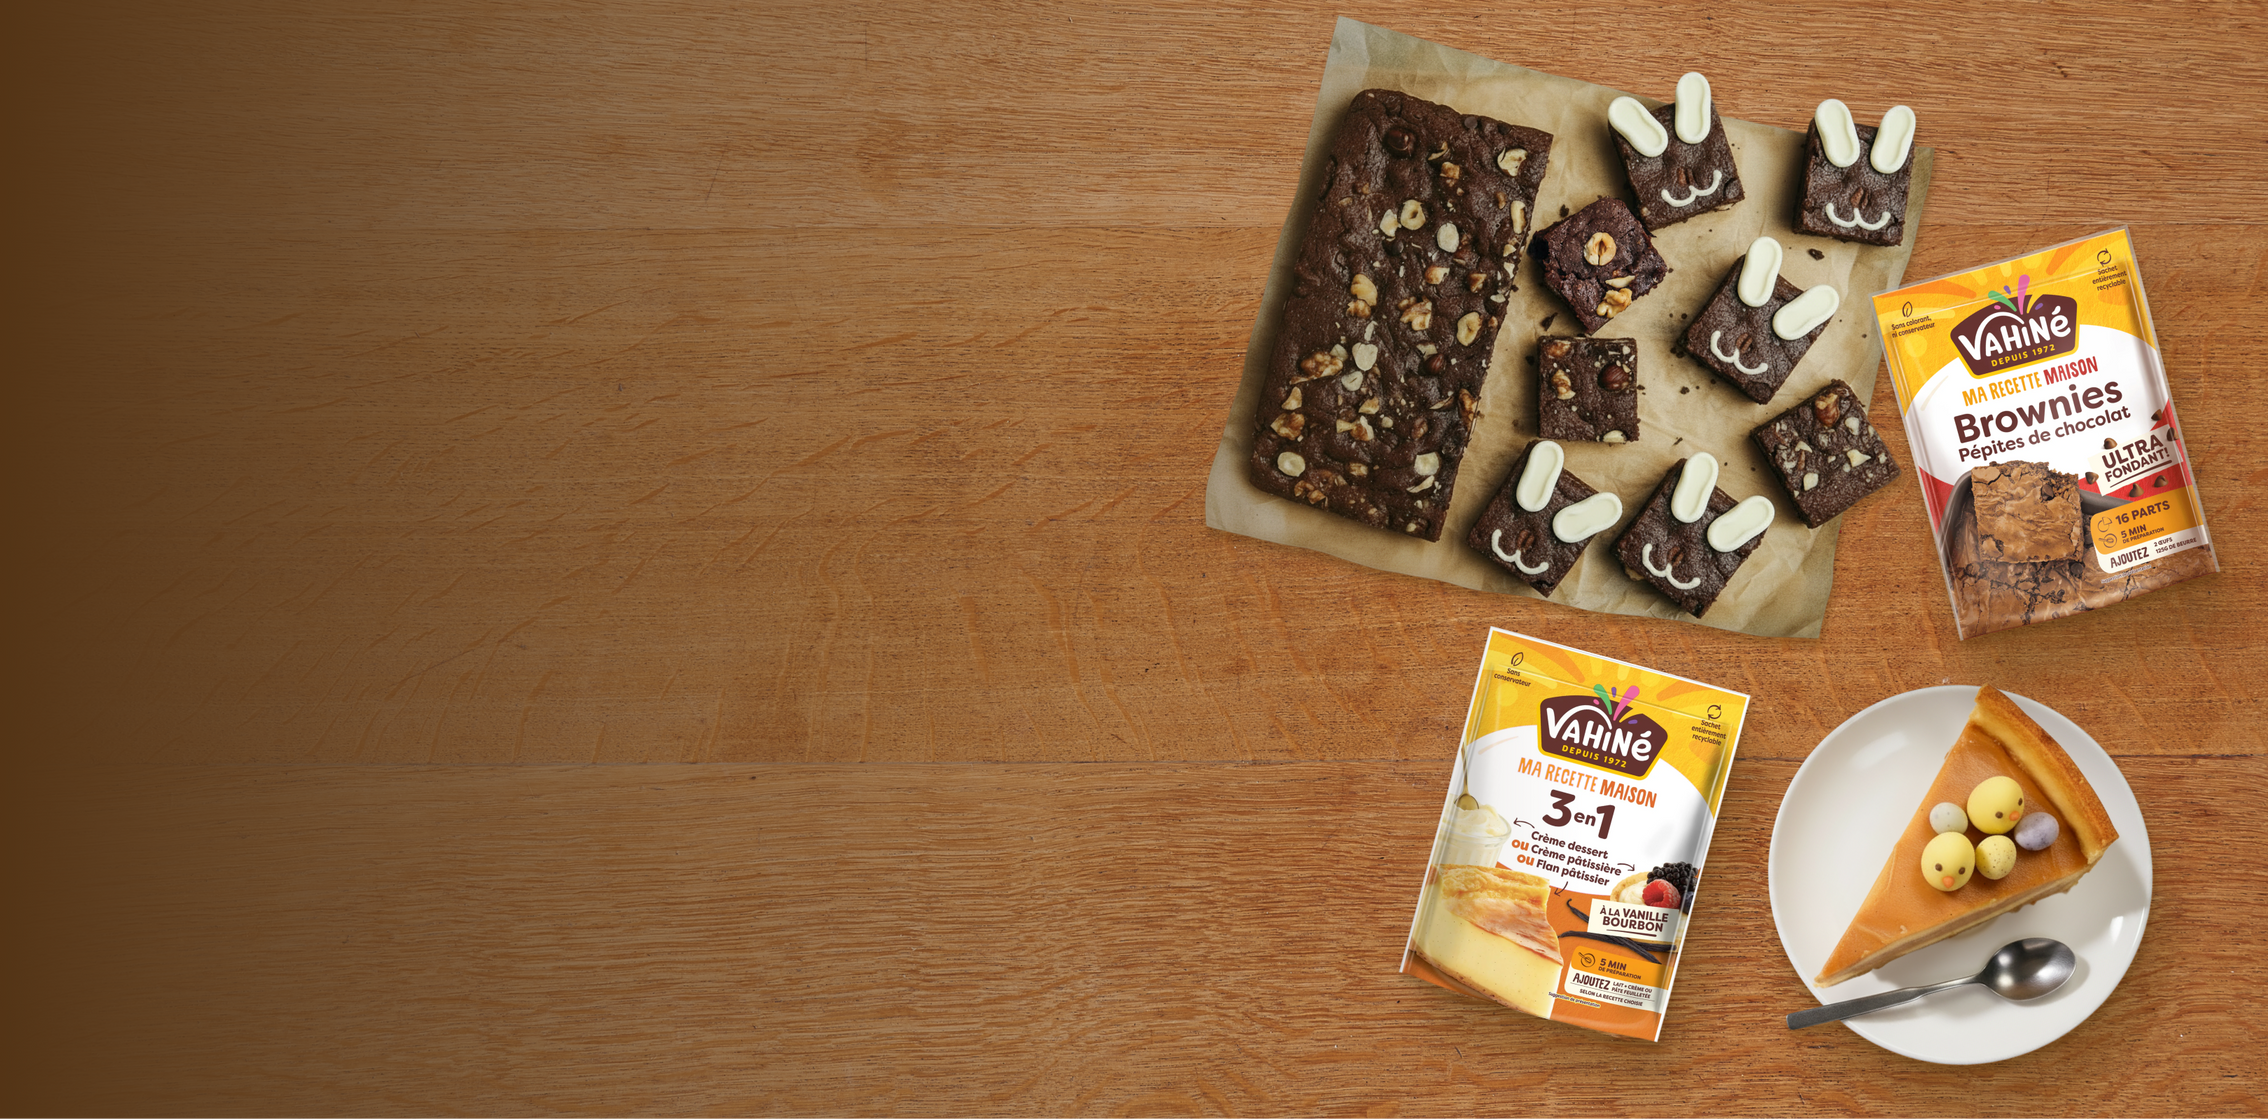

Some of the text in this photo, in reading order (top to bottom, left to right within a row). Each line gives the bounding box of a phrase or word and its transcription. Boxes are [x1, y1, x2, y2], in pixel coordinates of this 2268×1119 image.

[2098, 265, 2118, 275] Sachet
[2097, 279, 2126, 291] recyclable
[1892, 322, 1906, 330] Sans
[1898, 322, 1935, 336] conservateur
[1991, 344, 2056, 367] DEPUIS 1972
[1962, 356, 2099, 406] MA RECETTE MAISON
[1954, 381, 2123, 444] Brownies
[1958, 405, 2131, 462] Pépites de chocolat
[2102, 434, 2163, 469] ULTRA
[2105, 447, 2170, 482] FONDANT!
[2115, 500, 2170, 525] 16 PARTS
[2121, 524, 2147, 539] 5 MIN
[2130, 526, 2164, 542] PRÉPARATION
[2176, 537, 2197, 547] BEURRE
[2110, 546, 2149, 568] AJOUTEZ
[1494, 673, 1531, 687] conservateur
[1507, 667, 1520, 676] Sans
[1691, 726, 1726, 739] entièrement
[1701, 719, 1721, 730] Sachet
[1692, 734, 1721, 746] recyclable
[1561, 745, 1627, 768] DEPUIS 1972
[1518, 757, 1657, 808] MA RECETTE MAISON
[1531, 831, 1608, 859] Crème dessert
[1511, 839, 1621, 876] ou Crème pâtissière
[1517, 854, 1610, 886] ou Flan pâtissier
[1600, 905, 1669, 923] À LA VANILLE
[1602, 916, 1663, 932] BOURBON
[1600, 958, 1627, 971] 5 MIN
[1573, 972, 1611, 991] AJOUTEZ
[1606, 968, 1641, 980] PRÉPARATION
[1579, 988, 1595, 997] SELON
[1603, 993, 1623, 1003] RECETTE
[1624, 998, 1643, 1007] CHOISIE
[1611, 986, 1623, 994] PÂTE
